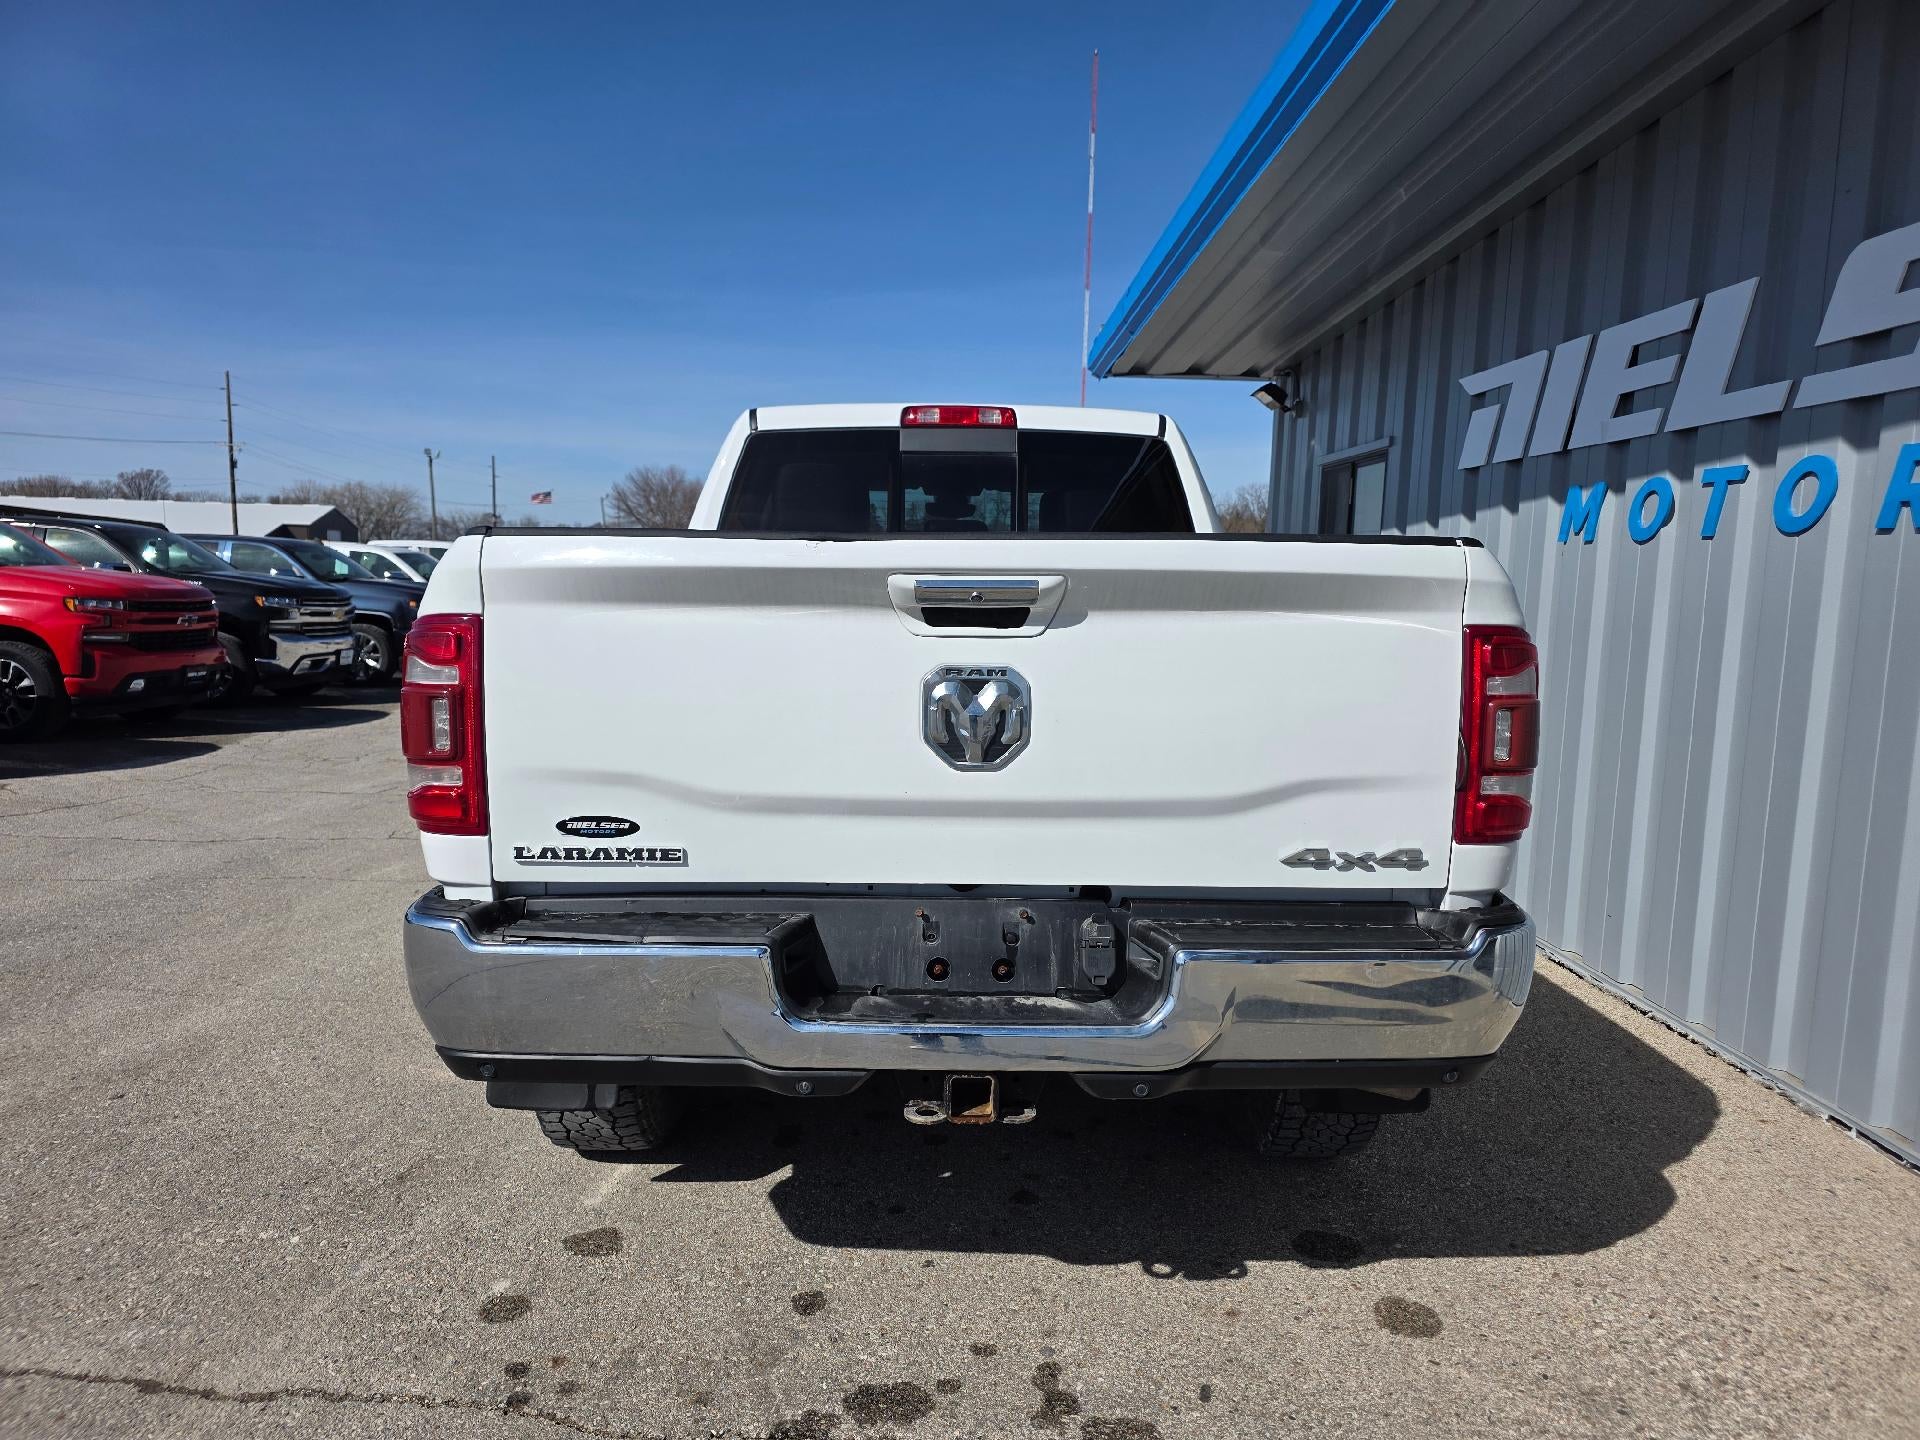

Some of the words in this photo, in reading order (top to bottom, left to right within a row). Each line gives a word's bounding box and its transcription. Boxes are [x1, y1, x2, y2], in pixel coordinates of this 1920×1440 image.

[945, 668, 1008, 677] RAM
[565, 821, 631, 829] NIELSEN
[513, 846, 684, 864] LARAMIE
